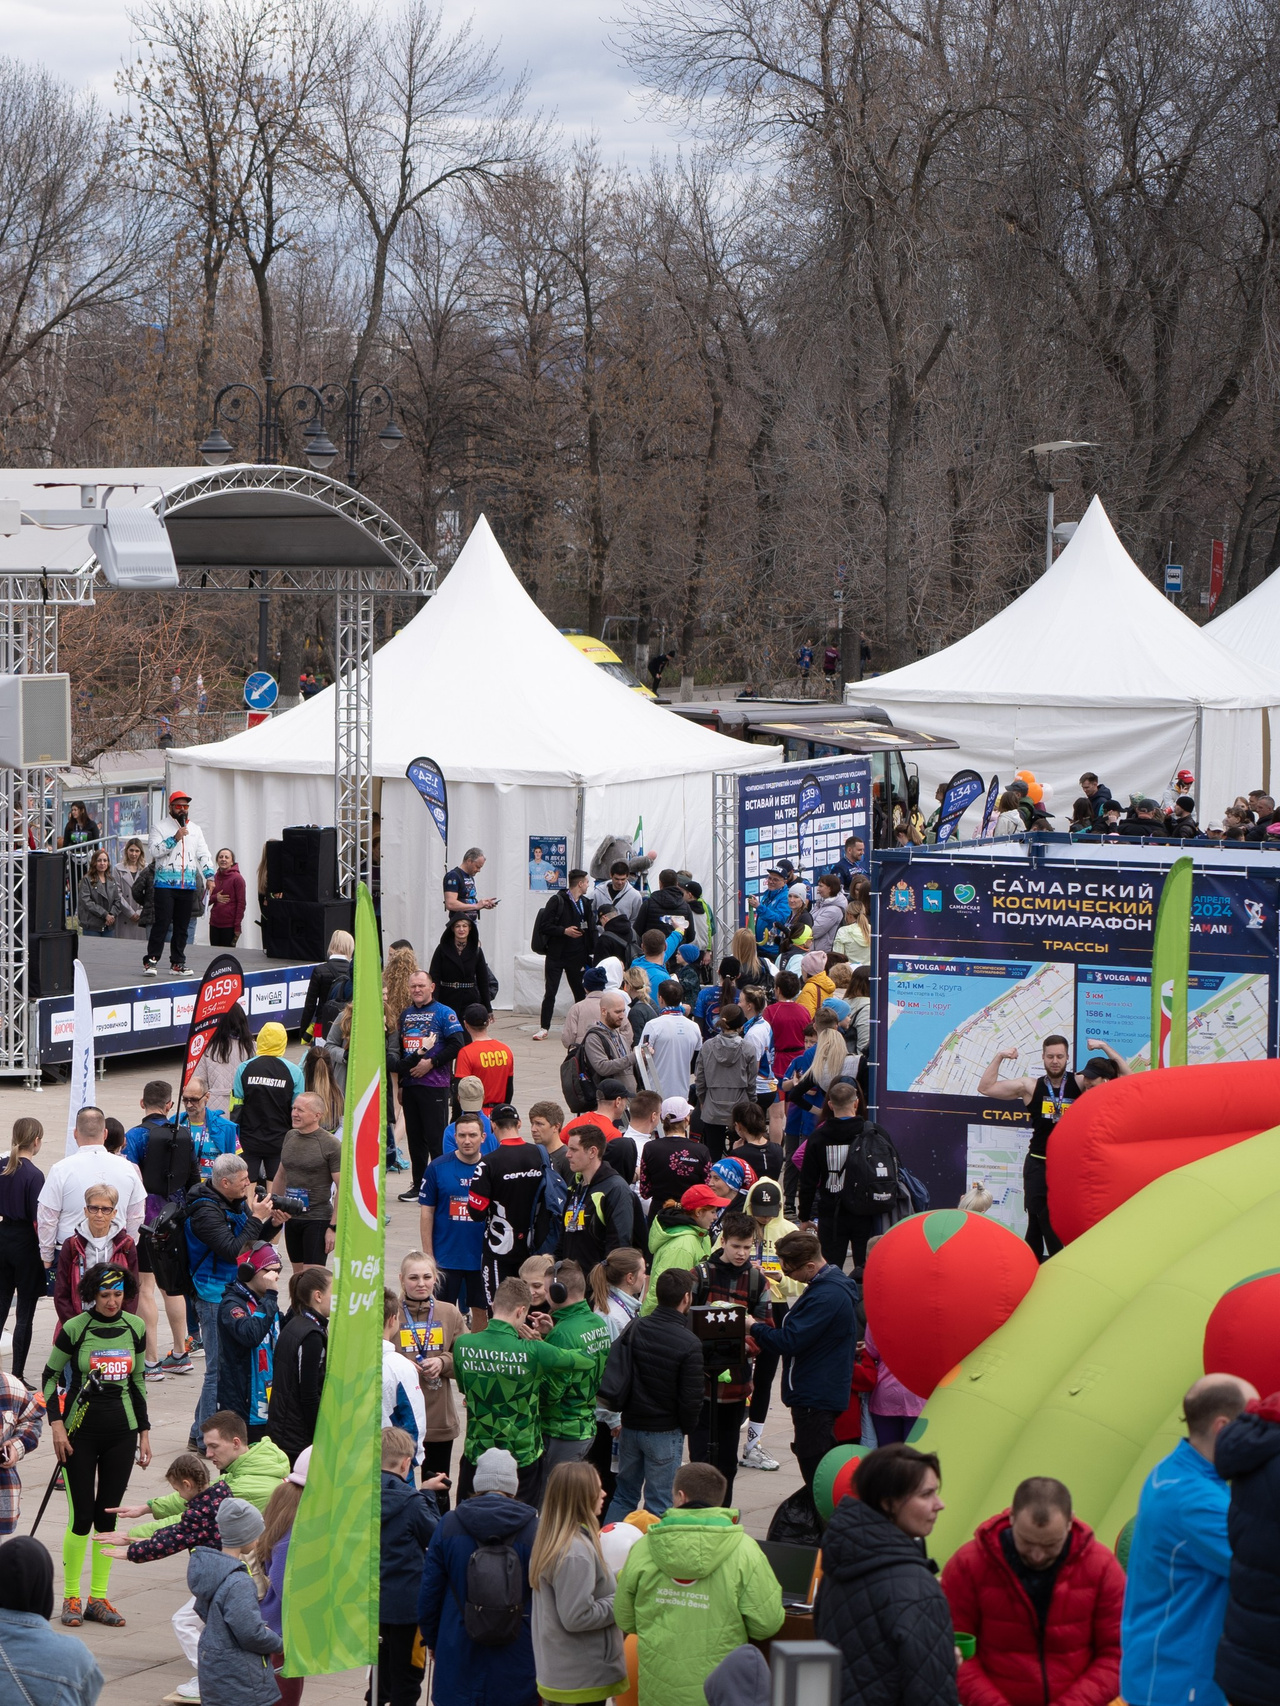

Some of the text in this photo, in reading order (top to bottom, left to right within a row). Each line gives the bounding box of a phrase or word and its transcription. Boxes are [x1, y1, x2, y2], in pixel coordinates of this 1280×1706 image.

[950, 784, 971, 803] 1:34
[745, 794, 774, 811] ВСТАВАЙ
[780, 793, 796, 807] БЕГИ
[832, 798, 864, 812] VOLGAMAN
[774, 810, 785, 820] НА
[992, 879, 1153, 899] САМАРСКИЙ
[992, 896, 1153, 915] КОСМИЧЕСКИЙ
[1193, 895, 1231, 904] АПРЕЛЯ
[1192, 903, 1233, 918] 2024
[992, 911, 1152, 931] ПОЛУМАРАФОН
[1042, 940, 1108, 953] ТРАССЫ
[211, 966, 232, 978] GARMIN
[914, 963, 957, 972] VOLGAMAN
[1104, 973, 1148, 983] VOLGAMAN
[204, 979, 232, 1002] 0:59
[897, 981, 911, 990] 21,1
[939, 984, 962, 993] круга
[256, 990, 282, 1003] NaviGAR
[934, 1002, 952, 1011] круг
[1085, 1010, 1104, 1018] 1586
[1085, 1027, 1101, 1035] 600
[502, 1168, 543, 1181] cervélo
[481, 1264, 494, 1306] cervélo
[459, 1346, 528, 1363] ТОМСКАЯ
[462, 1359, 526, 1375] ОБЛАСТЬ
[655, 1597, 710, 1609] каждый день!
[686, 1592, 710, 1601] гости
